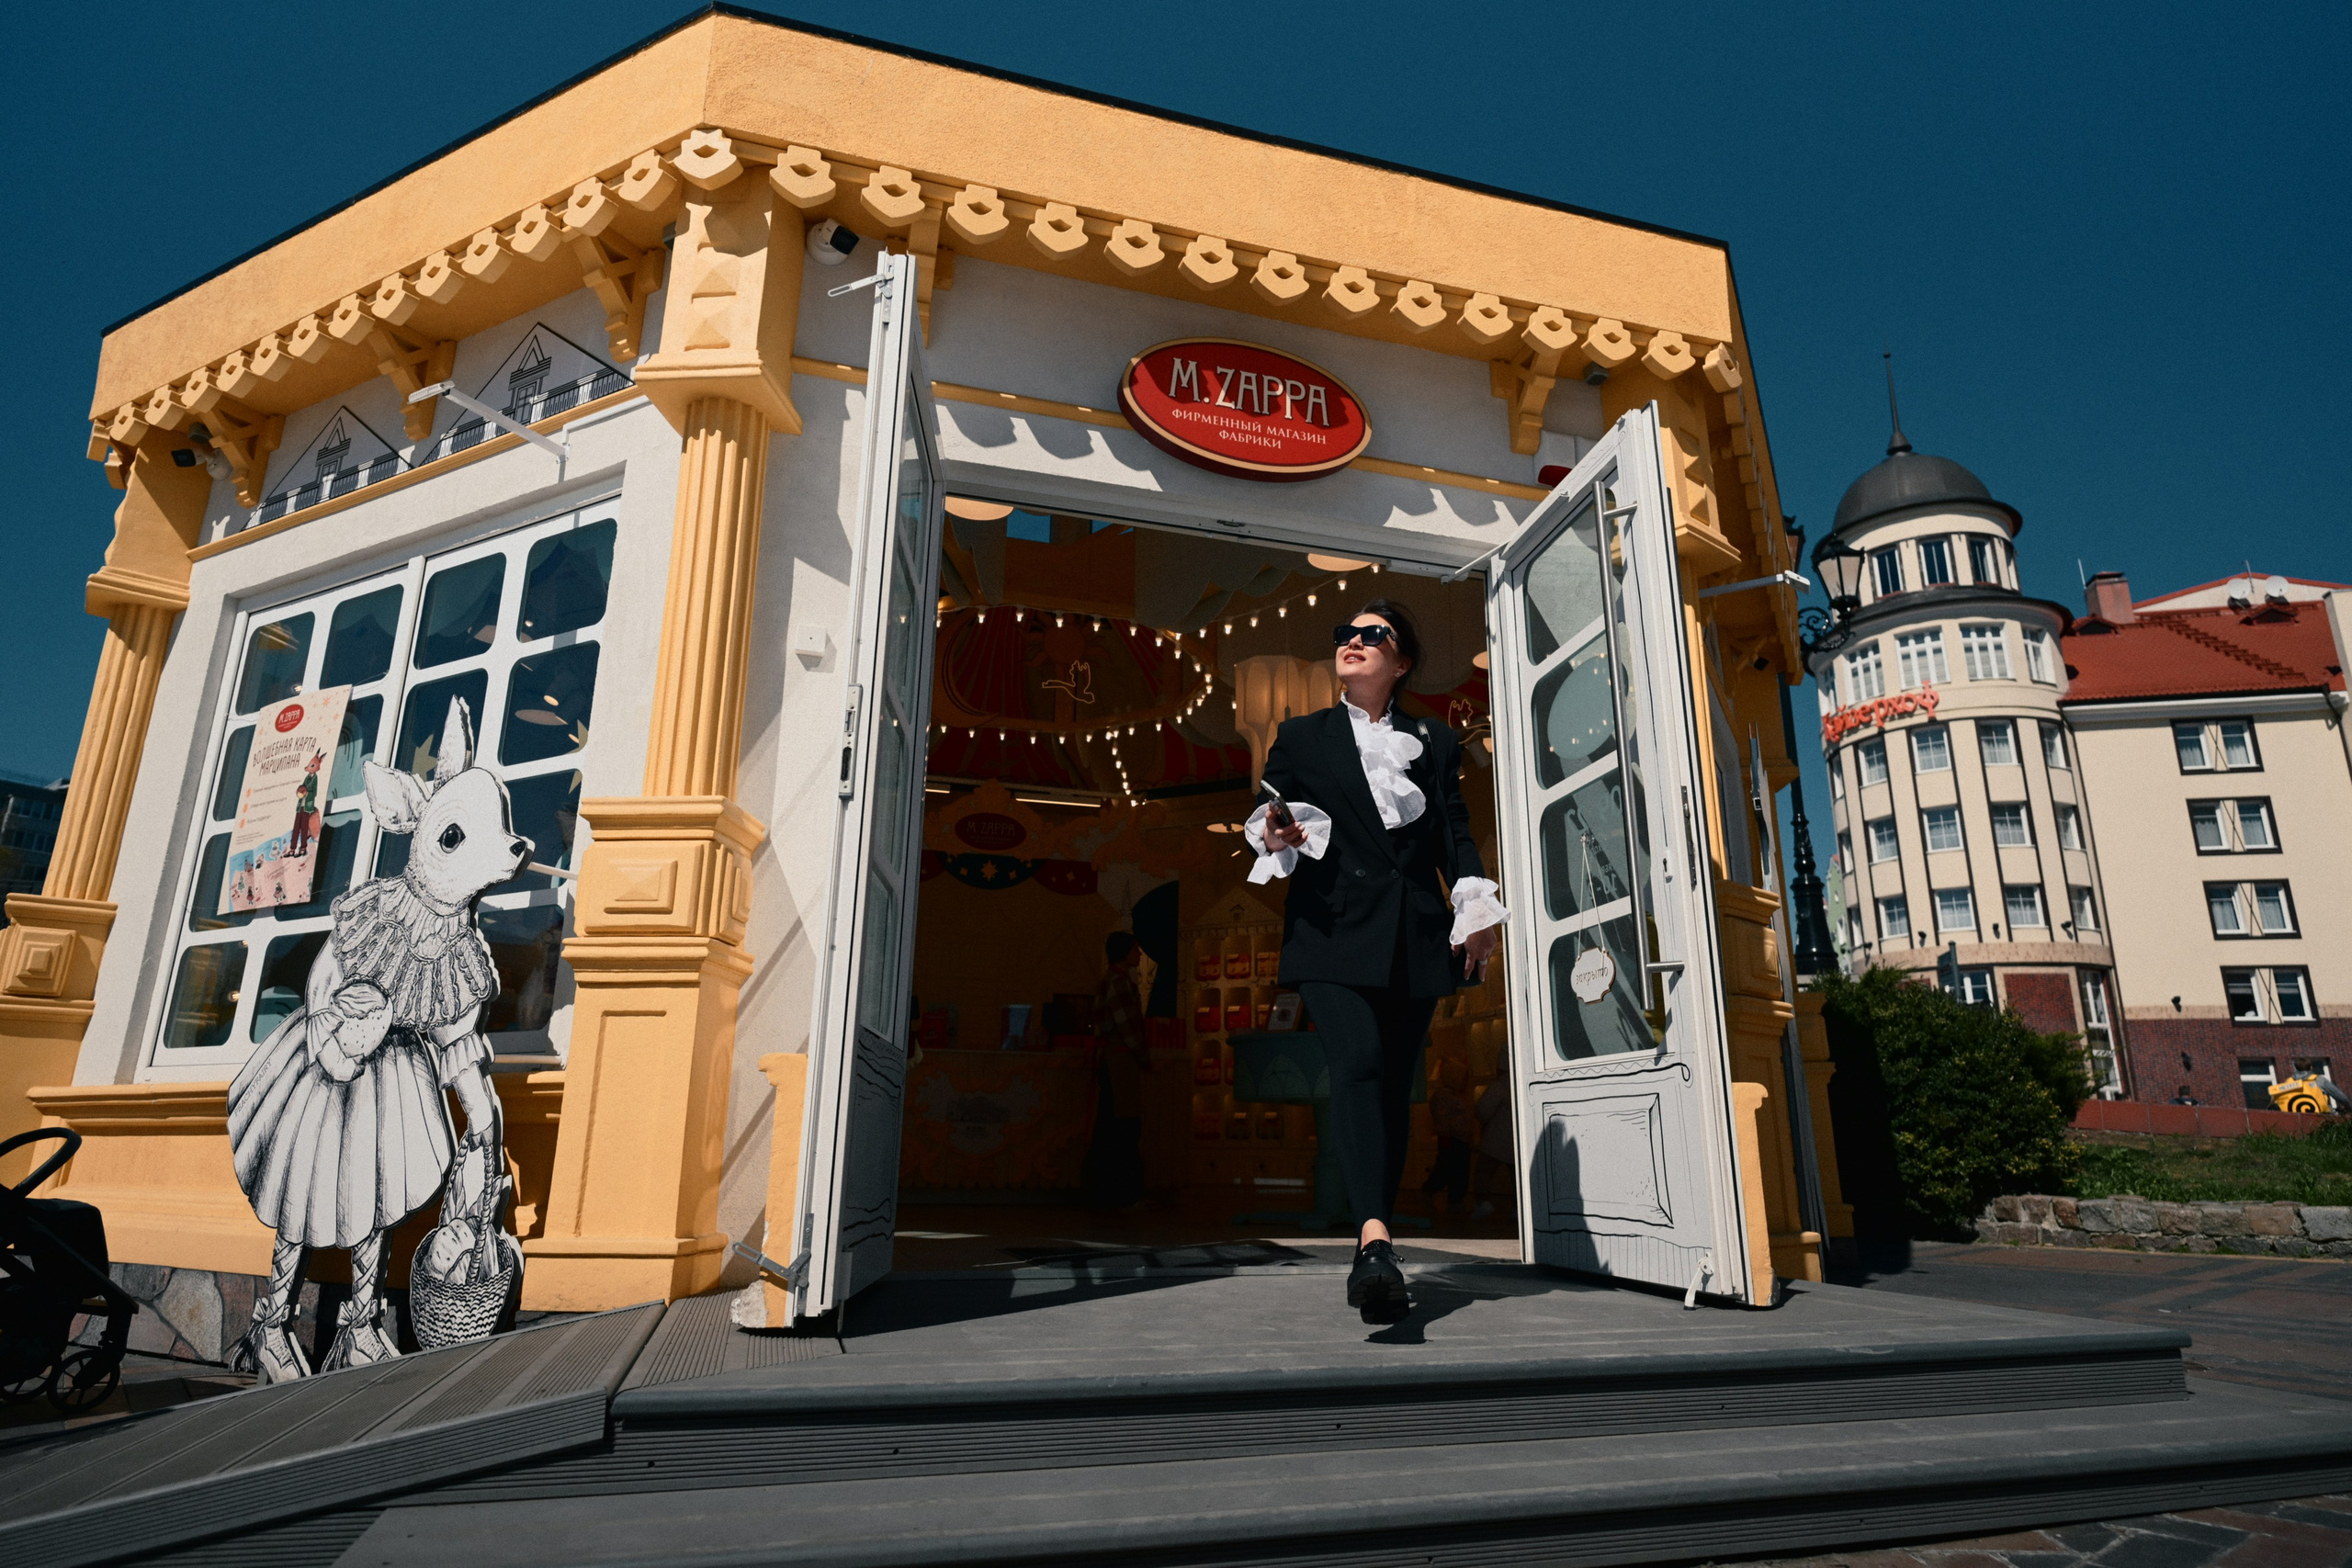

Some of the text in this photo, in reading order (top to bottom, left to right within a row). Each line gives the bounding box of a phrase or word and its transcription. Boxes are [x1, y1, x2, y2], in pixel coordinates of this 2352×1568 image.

[1171, 408, 1328, 445] ФИРМЕННЫЙ МАГАЗИН
[1218, 430, 1283, 449] ФАБРИКИ
[253, 736, 318, 767] ВОЛШЕБНАЯ КАРТА
[258, 752, 301, 777] МАРЦИПАНА
[1576, 966, 1609, 987] закрыто
[233, 1057, 272, 1117] PEACHYFAIRY
